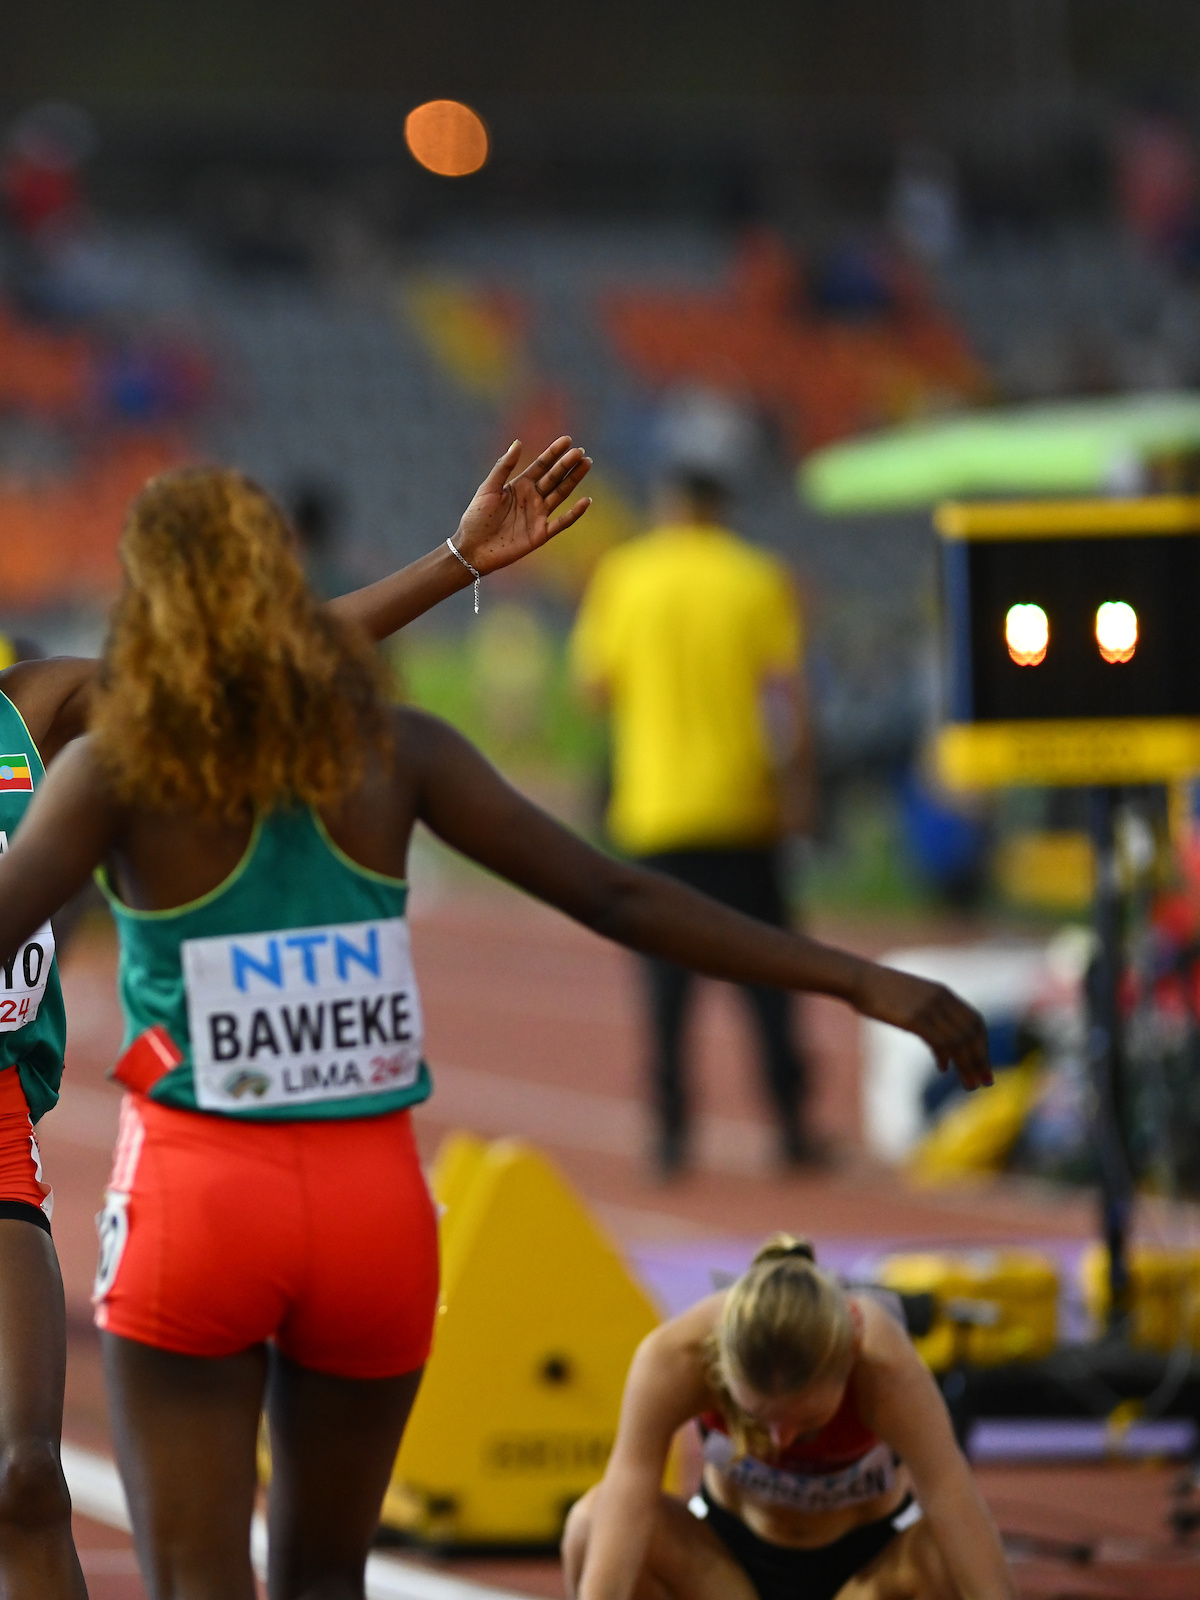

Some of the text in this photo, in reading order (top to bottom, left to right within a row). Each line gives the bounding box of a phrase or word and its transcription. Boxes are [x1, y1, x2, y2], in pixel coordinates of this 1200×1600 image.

[230, 926, 381, 993] NTN
[209, 991, 412, 1062] BAWEKE
[282, 1058, 364, 1093] LIMA
